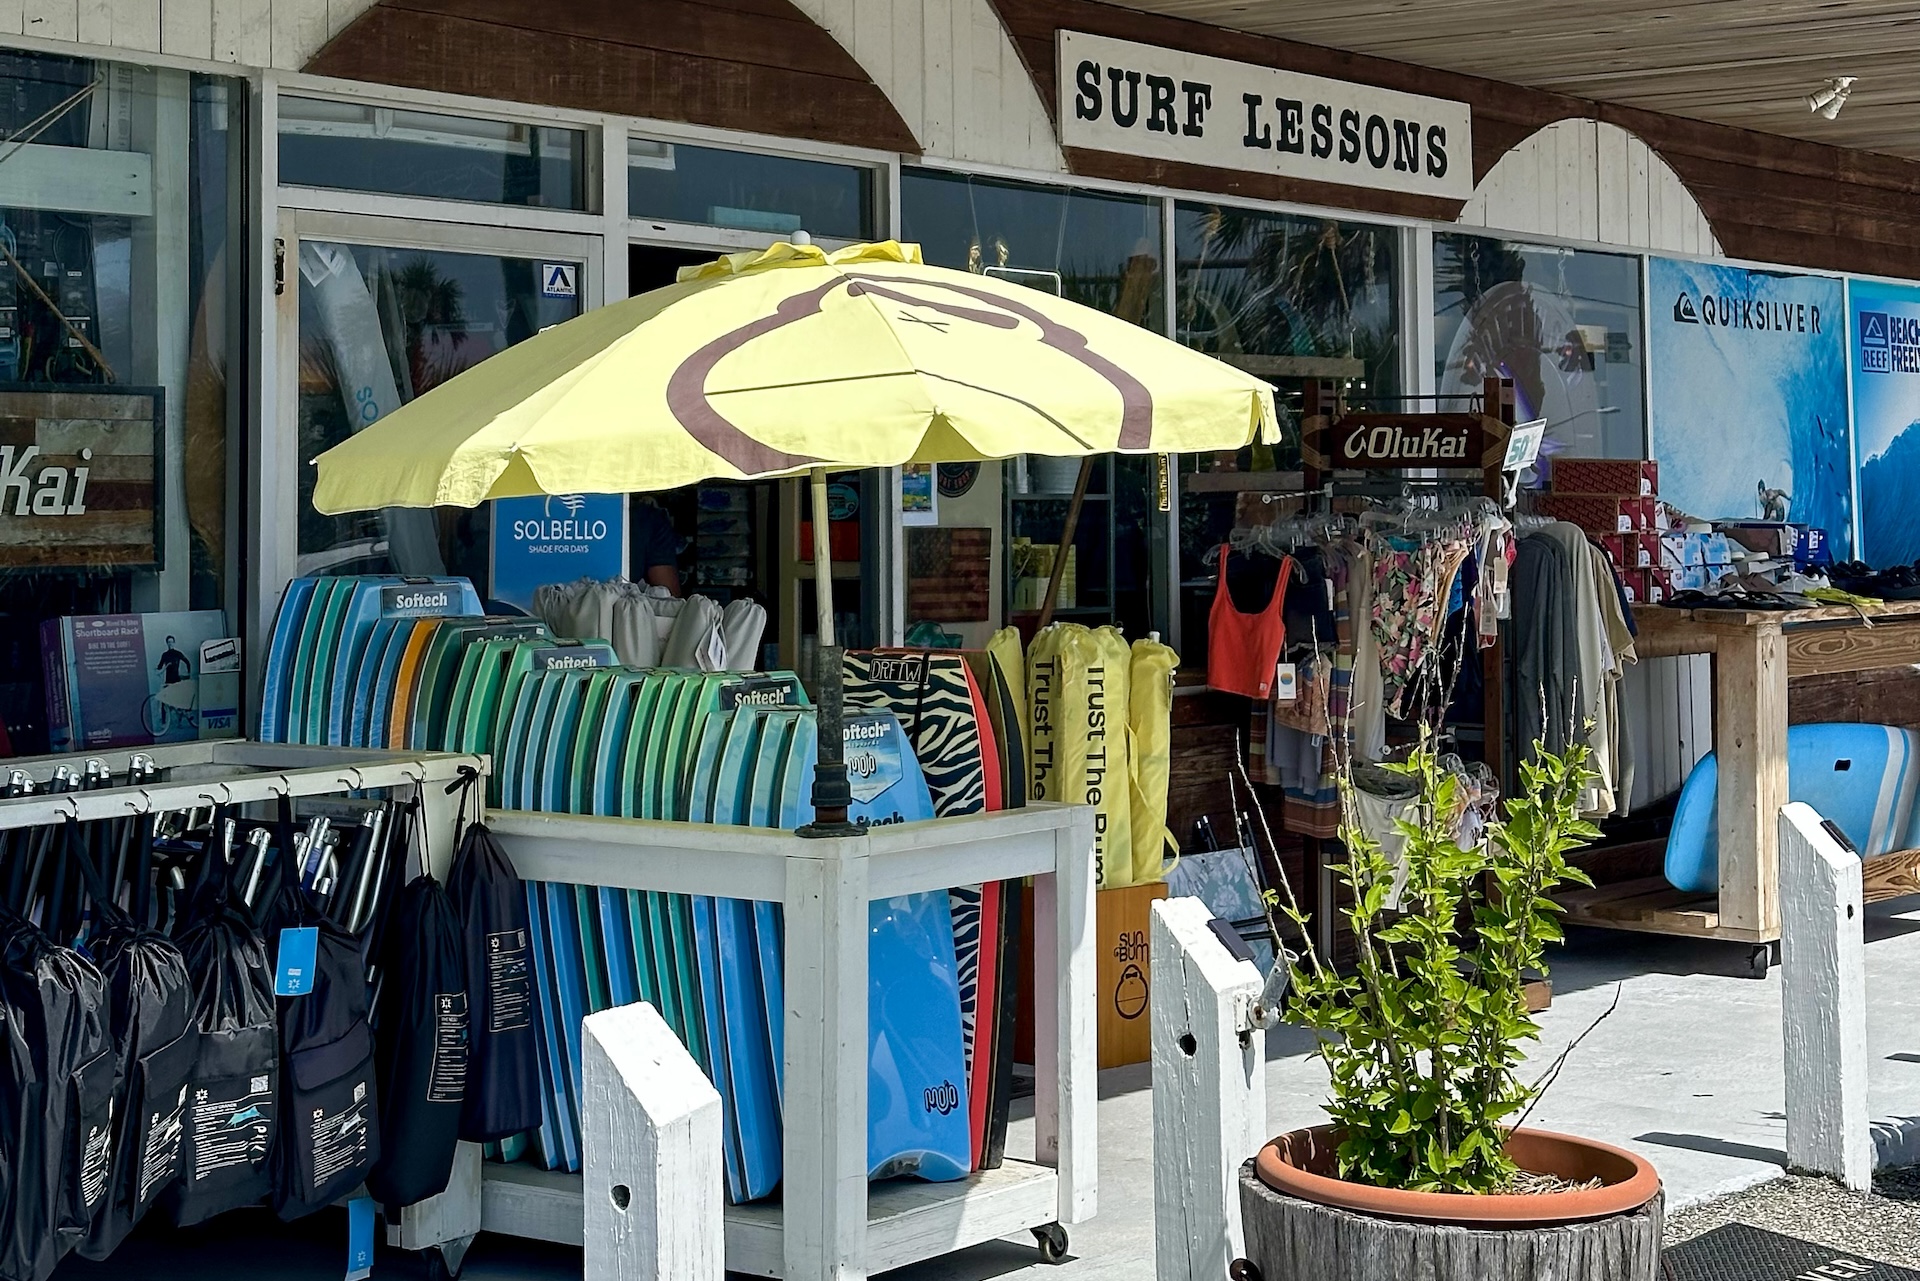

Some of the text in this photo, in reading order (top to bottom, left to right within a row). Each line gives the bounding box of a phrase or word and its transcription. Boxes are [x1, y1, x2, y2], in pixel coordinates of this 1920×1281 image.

[1075, 59, 1449, 179] SURF LESSONS
[1702, 294, 1822, 334] QUIKSILVER
[1863, 349, 1888, 368] REEF
[1366, 426, 1469, 459] OluKai
[513, 519, 607, 541] SOLBELLO
[528, 544, 589, 554] SHADE FOR DAYS
[396, 592, 448, 609] Softech
[75, 627, 139, 638] Shortboard Rack
[547, 655, 597, 670] Softech
[734, 688, 785, 707] Softech
[1087, 665, 1106, 741] Trust
[207, 717, 232, 729] VISA
[842, 722, 884, 741] oftech
[1034, 655, 1055, 800] Trust The
[1086, 746, 1106, 806] The
